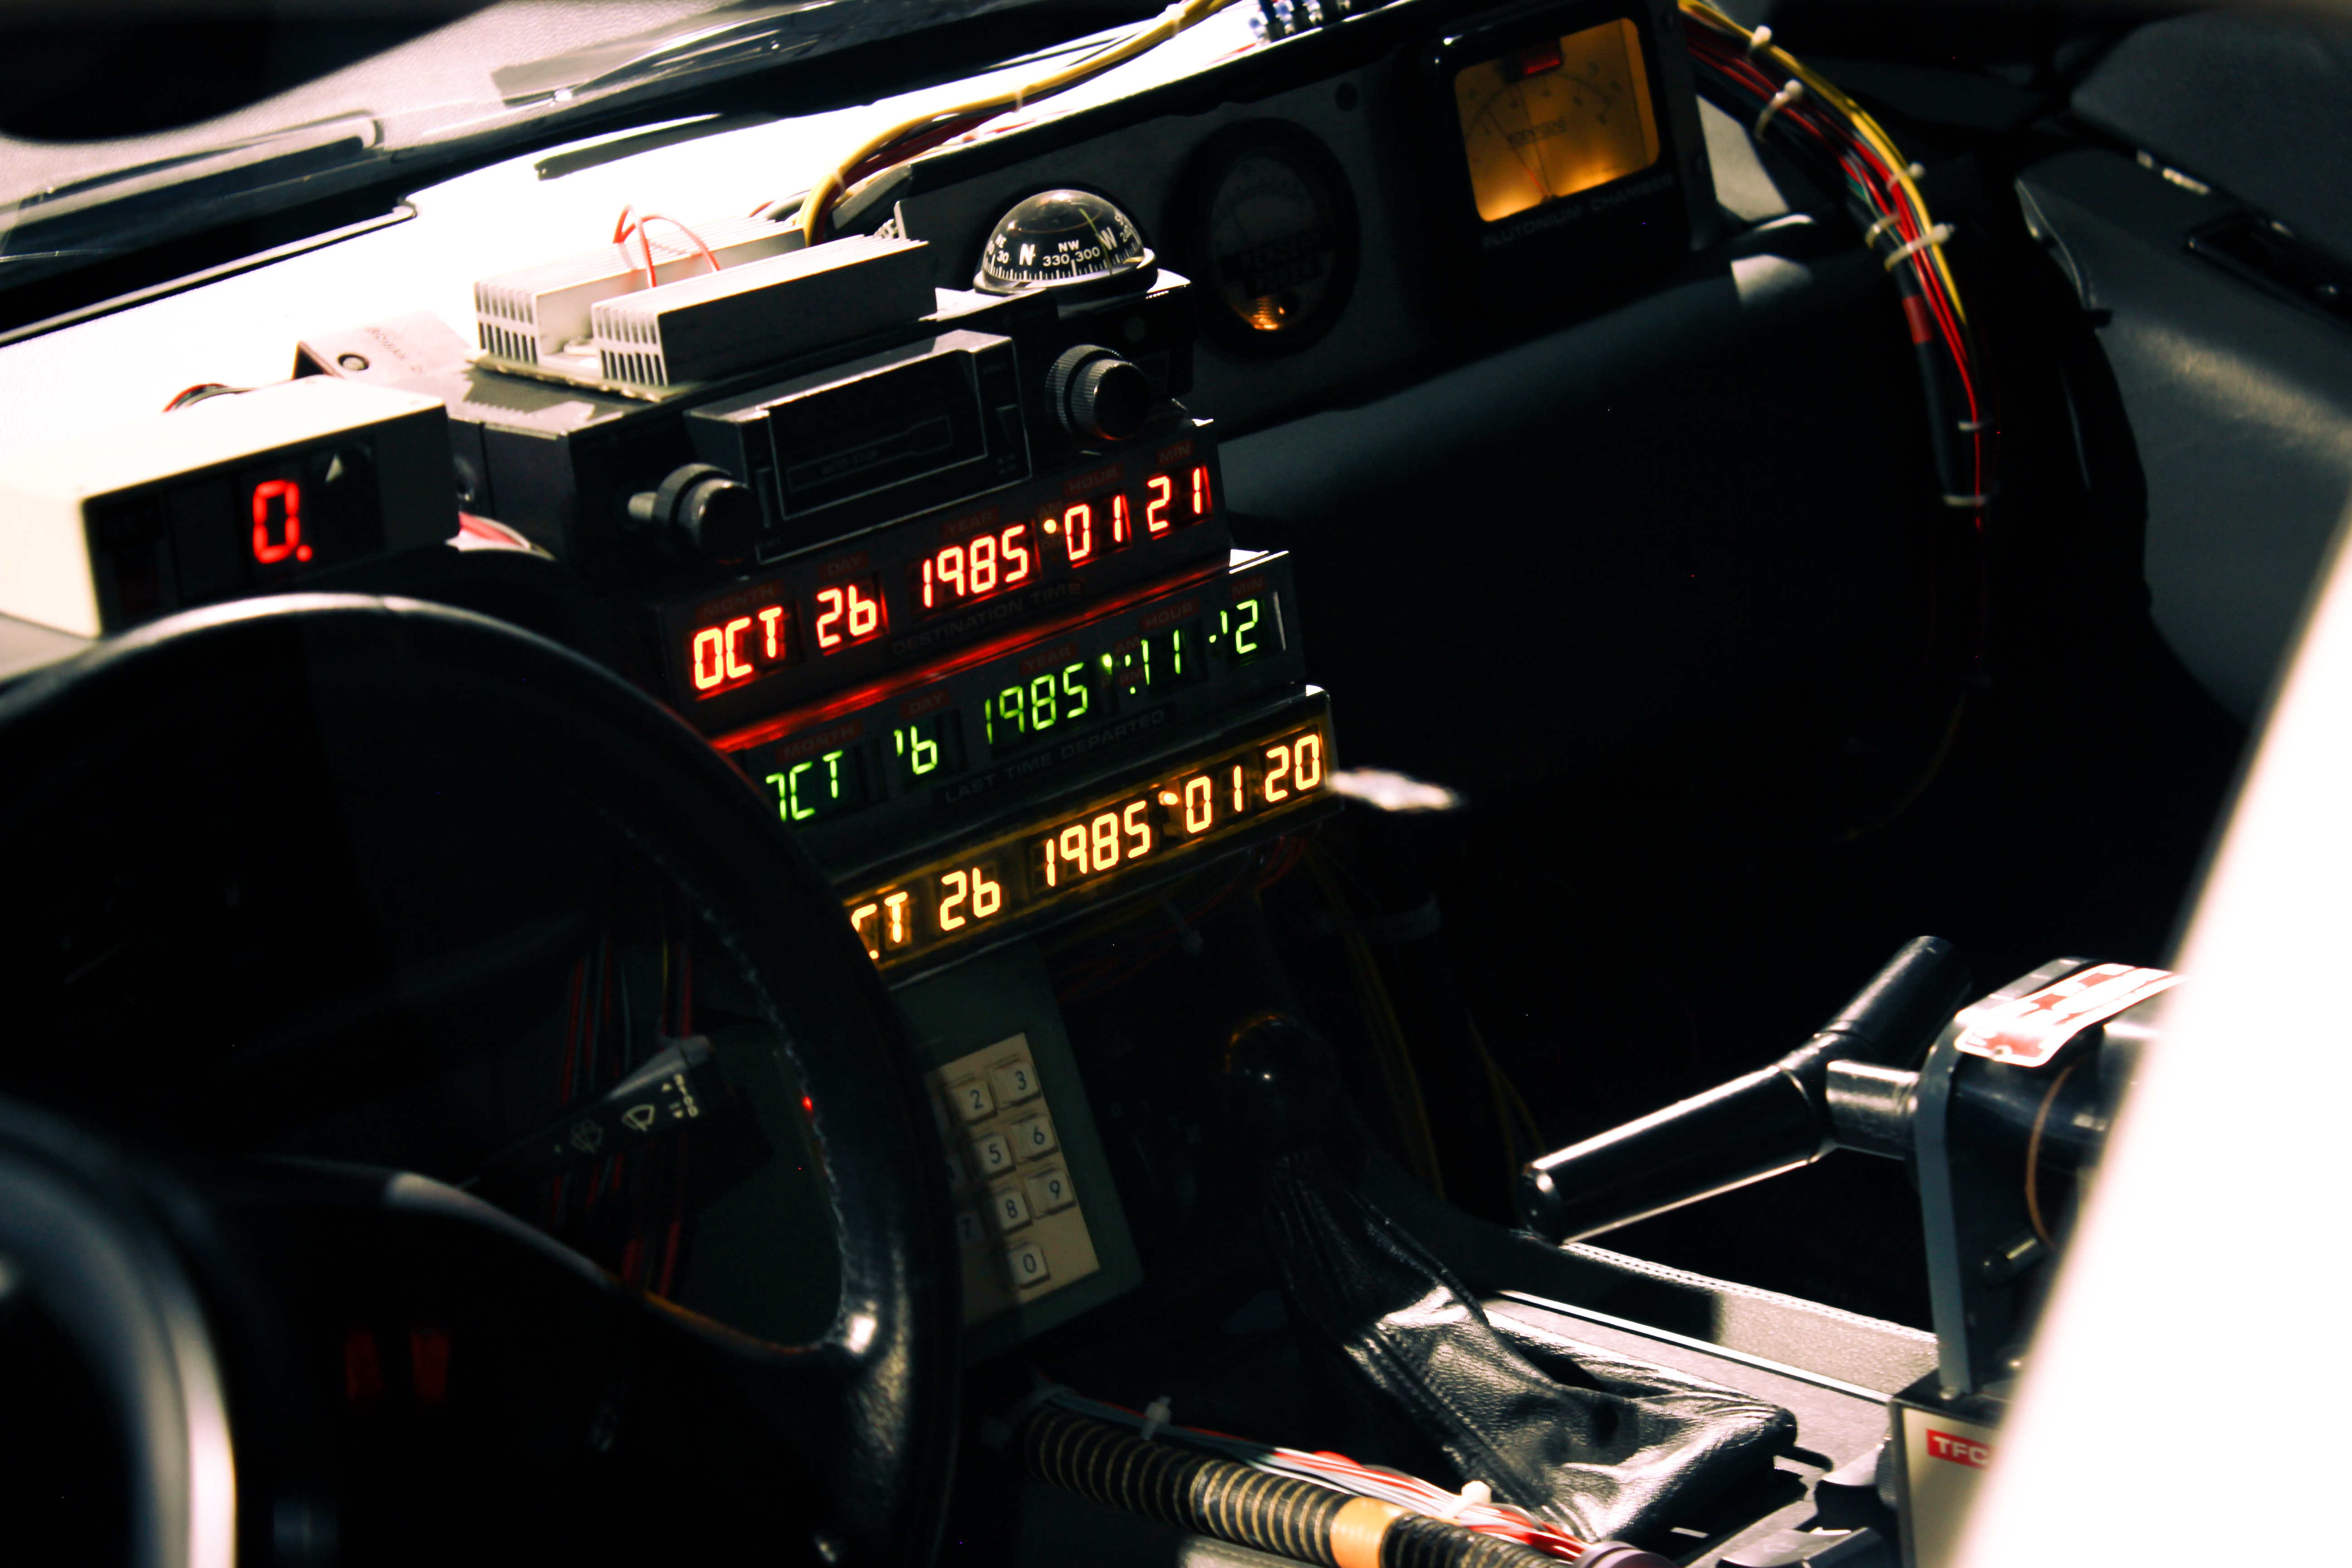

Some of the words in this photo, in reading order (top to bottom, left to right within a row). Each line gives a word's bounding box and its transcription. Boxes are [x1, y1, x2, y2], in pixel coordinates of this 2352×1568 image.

[1058, 239, 1080, 253] NW
[1095, 227, 1118, 251] W
[996, 250, 1009, 264] 30
[1019, 243, 1036, 266] N
[1043, 252, 1070, 267] 330
[1074, 245, 1101, 263] 300
[1159, 443, 1191, 465] MIN
[1068, 467, 1118, 492] HOUR
[1038, 501, 1064, 519] AM
[946, 511, 993, 534] YEAR
[827, 555, 863, 576] DAY
[694, 605, 784, 690] OCT
[816, 584, 877, 648] 26
[922, 524, 1029, 609] 1985
[1063, 495, 1123, 562] 01
[1147, 466, 1203, 533] 21
[1232, 578, 1264, 598] MIN
[702, 586, 775, 619] MONTH
[892, 597, 1024, 656] DESTINATION
[1030, 581, 1084, 607] TIME
[1146, 602, 1195, 628] HOUR
[1024, 646, 1071, 671] YEAR
[908, 693, 943, 715] DAY
[985, 662, 1088, 745] 1985
[783, 725, 854, 760] MONTH
[944, 775, 995, 804] LAST
[1003, 752, 1053, 780] TIME
[1061, 709, 1165, 760] DEPARTED
[940, 867, 1001, 931] 26
[1045, 800, 1151, 887] 1985
[1185, 765, 1243, 834] 01
[1264, 734, 1320, 803] 20
[970, 1089, 984, 1110] 2
[1014, 1069, 1027, 1090] 3
[989, 1143, 1002, 1164] 5
[1033, 1125, 1046, 1145] 6
[1005, 1199, 1019, 1219] 8
[1049, 1179, 1062, 1200] 9
[1023, 1253, 1037, 1274] 0
